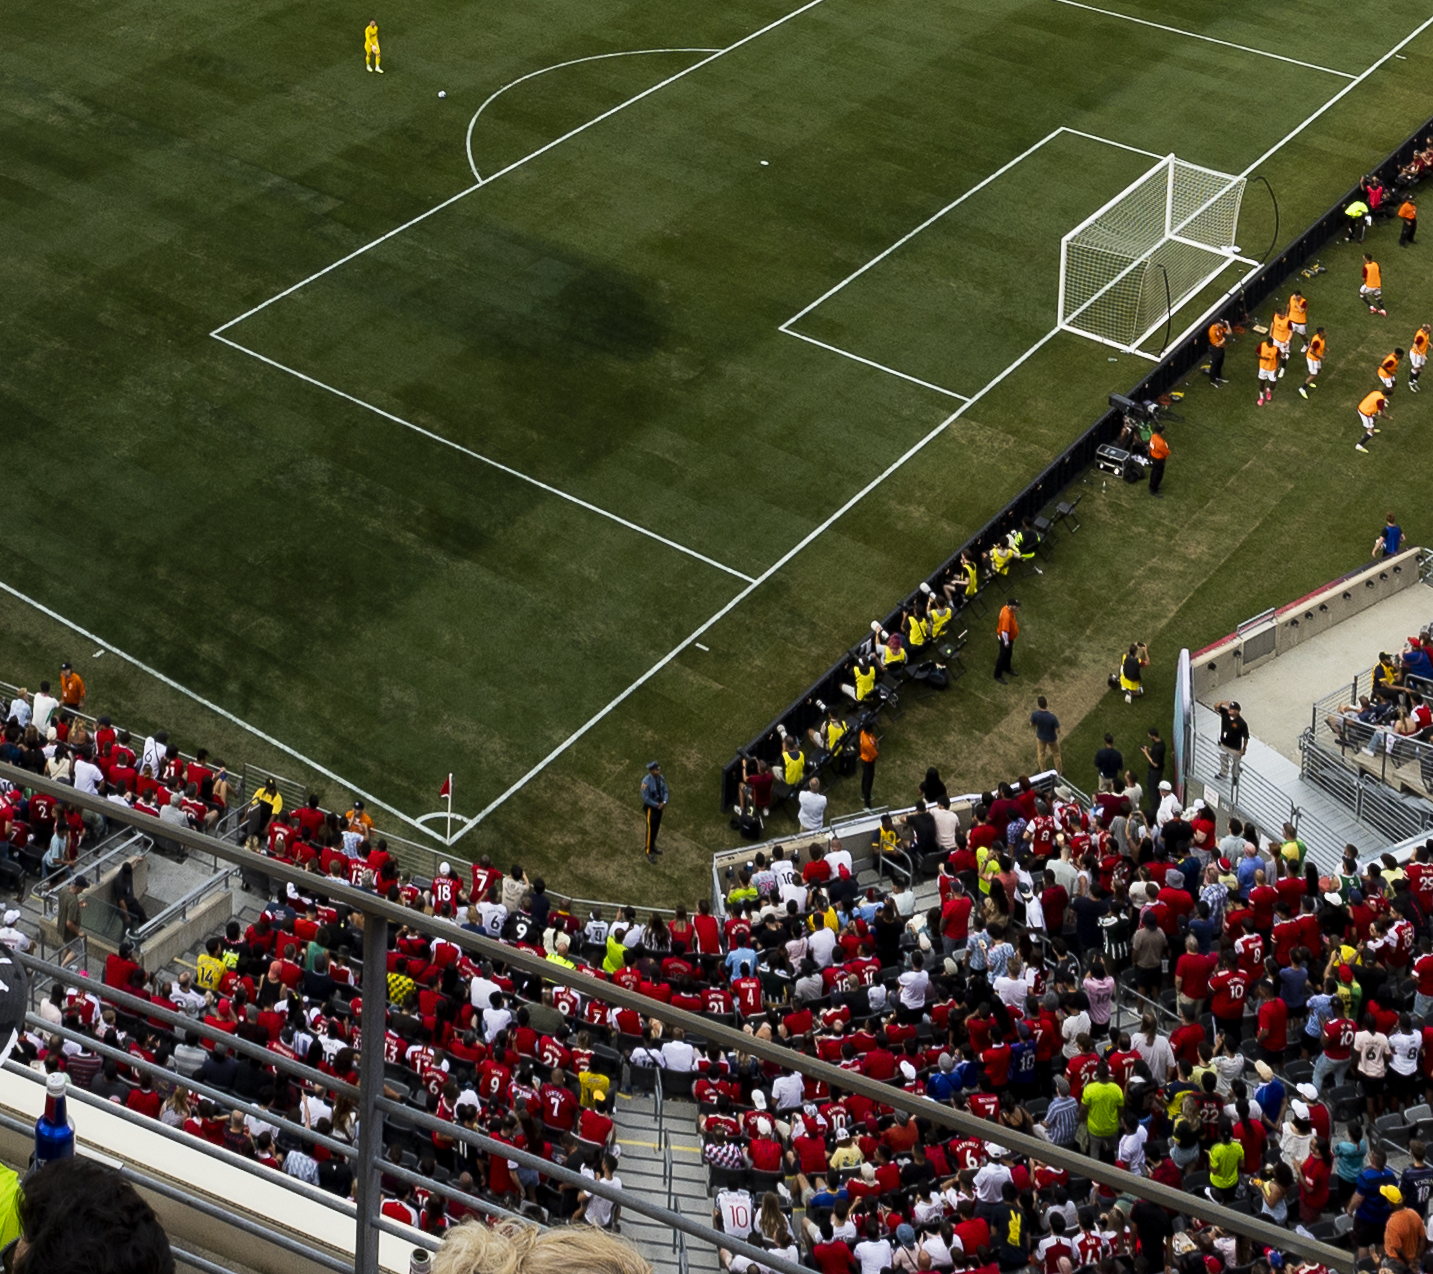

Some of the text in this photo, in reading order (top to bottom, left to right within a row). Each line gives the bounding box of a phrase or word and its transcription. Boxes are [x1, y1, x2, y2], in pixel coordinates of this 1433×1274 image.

[477, 874, 488, 891] 7
[439, 884, 452, 902] 18
[491, 915, 500, 930] 6
[516, 923, 528, 939] 9
[200, 966, 214, 983] 14
[729, 1205, 749, 1228] 10
